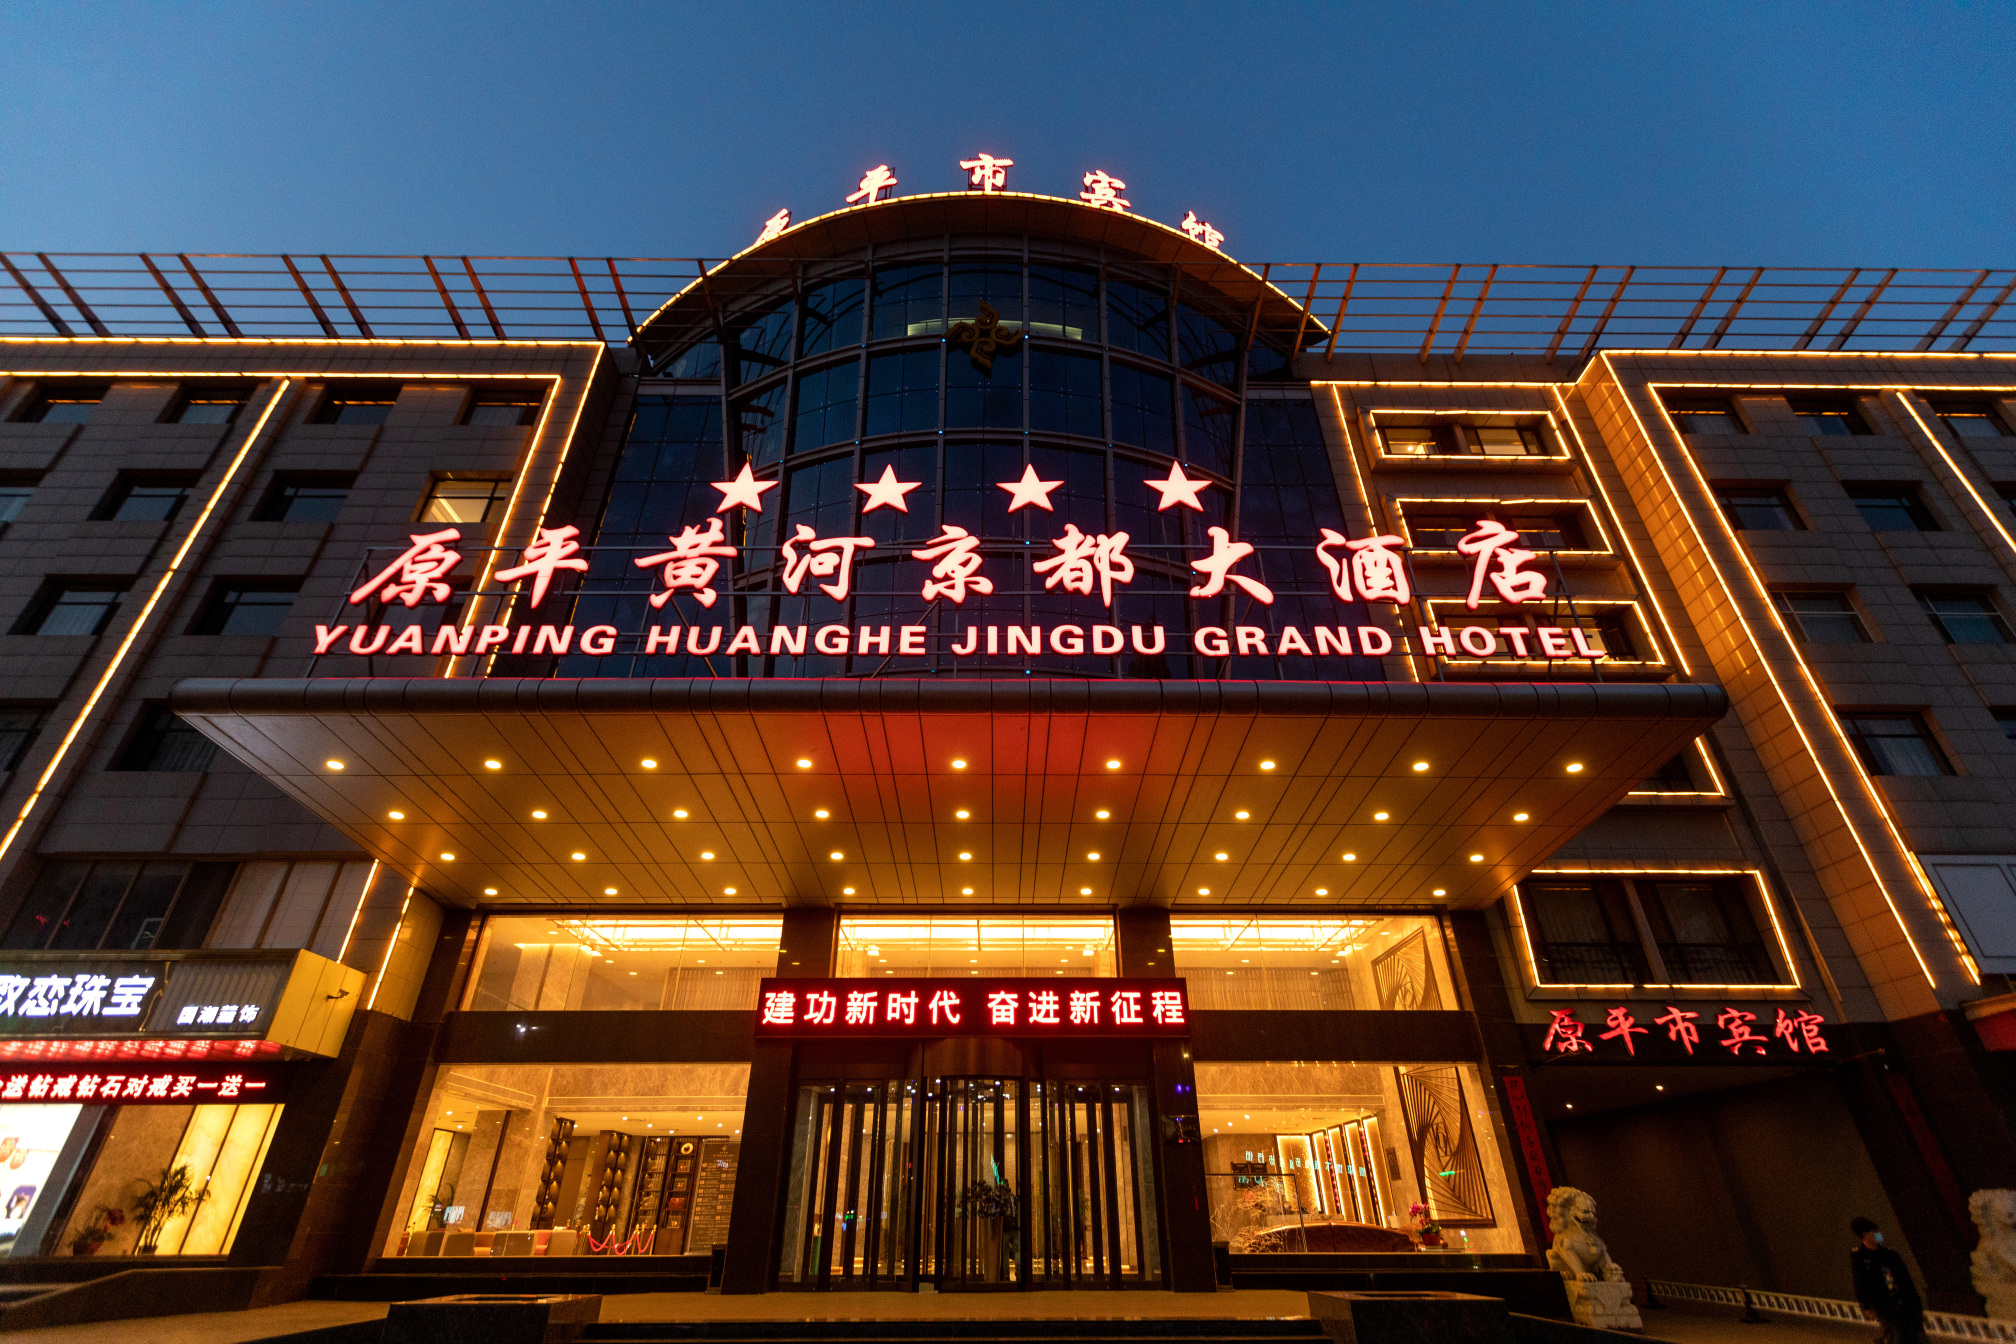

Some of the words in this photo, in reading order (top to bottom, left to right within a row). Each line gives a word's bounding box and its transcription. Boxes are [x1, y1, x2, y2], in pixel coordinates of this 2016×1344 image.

[754, 153, 1226, 251] 原平市宾馆
[349, 517, 1549, 611] 原平黄河京都大酒店
[313, 623, 618, 657] YUANPING
[644, 624, 928, 656] HUANGHE
[950, 624, 1168, 656] JINGDU
[1193, 625, 1394, 657] GRAND
[1418, 625, 1607, 660] HOTEL
[762, 990, 962, 1025] 建功新时代
[987, 990, 1186, 1025] 奋进新征程
[1543, 1006, 1830, 1056] 原平市宾馆
[0, 1074, 267, 1099] 送钻戒钻石对戒买一送一
